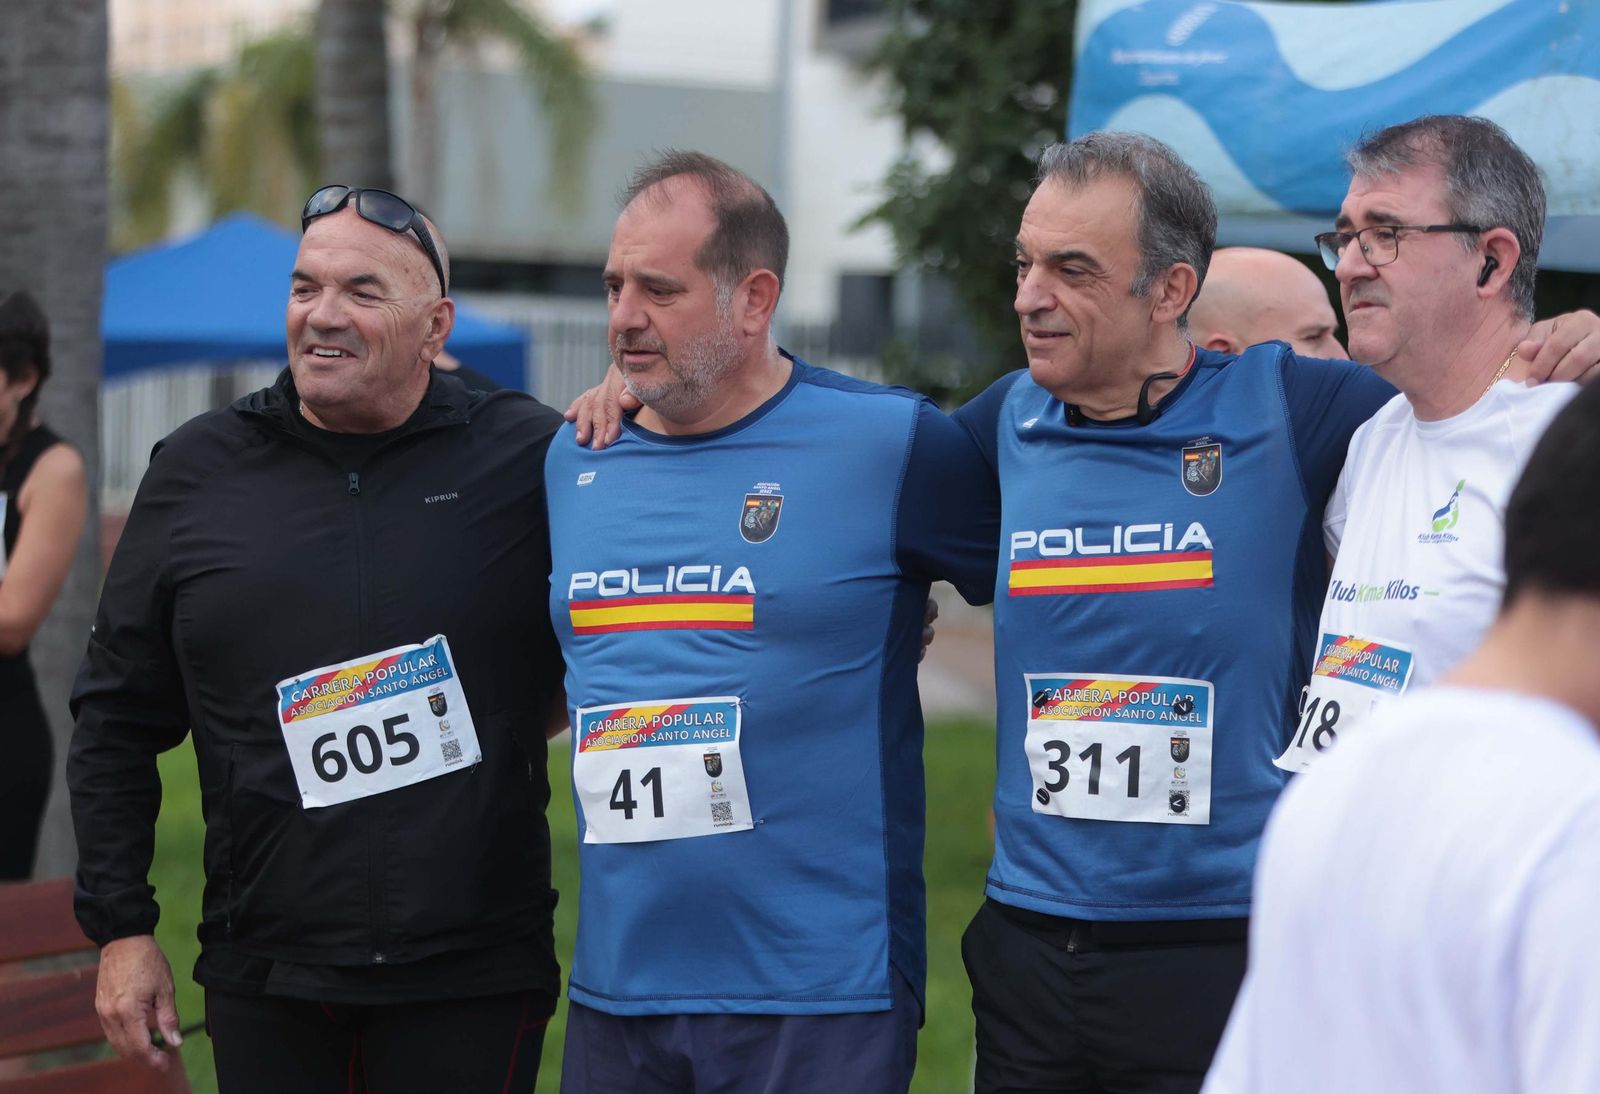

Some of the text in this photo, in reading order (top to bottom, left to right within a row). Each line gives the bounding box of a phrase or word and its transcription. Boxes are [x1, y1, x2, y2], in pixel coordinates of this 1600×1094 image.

[424, 492, 458, 503] KIPRUN
[1355, 650, 1400, 673] POPULAR
[290, 654, 438, 703] CARRERA POPULAR
[1346, 665, 1370, 681] SANTO
[1370, 673, 1400, 690] ANGEL
[290, 666, 449, 718] ASOCIACION SANTO ANGEL
[588, 712, 725, 733] CARRERA POPULAR
[1038, 705, 1111, 718] ASOCIACION
[1114, 708, 1156, 720] SANTO
[311, 713, 420, 783] 605
[585, 728, 731, 748] ASOCIACION SANTO ANGEL
[1043, 739, 1141, 798] 311
[609, 767, 664, 820] 41
